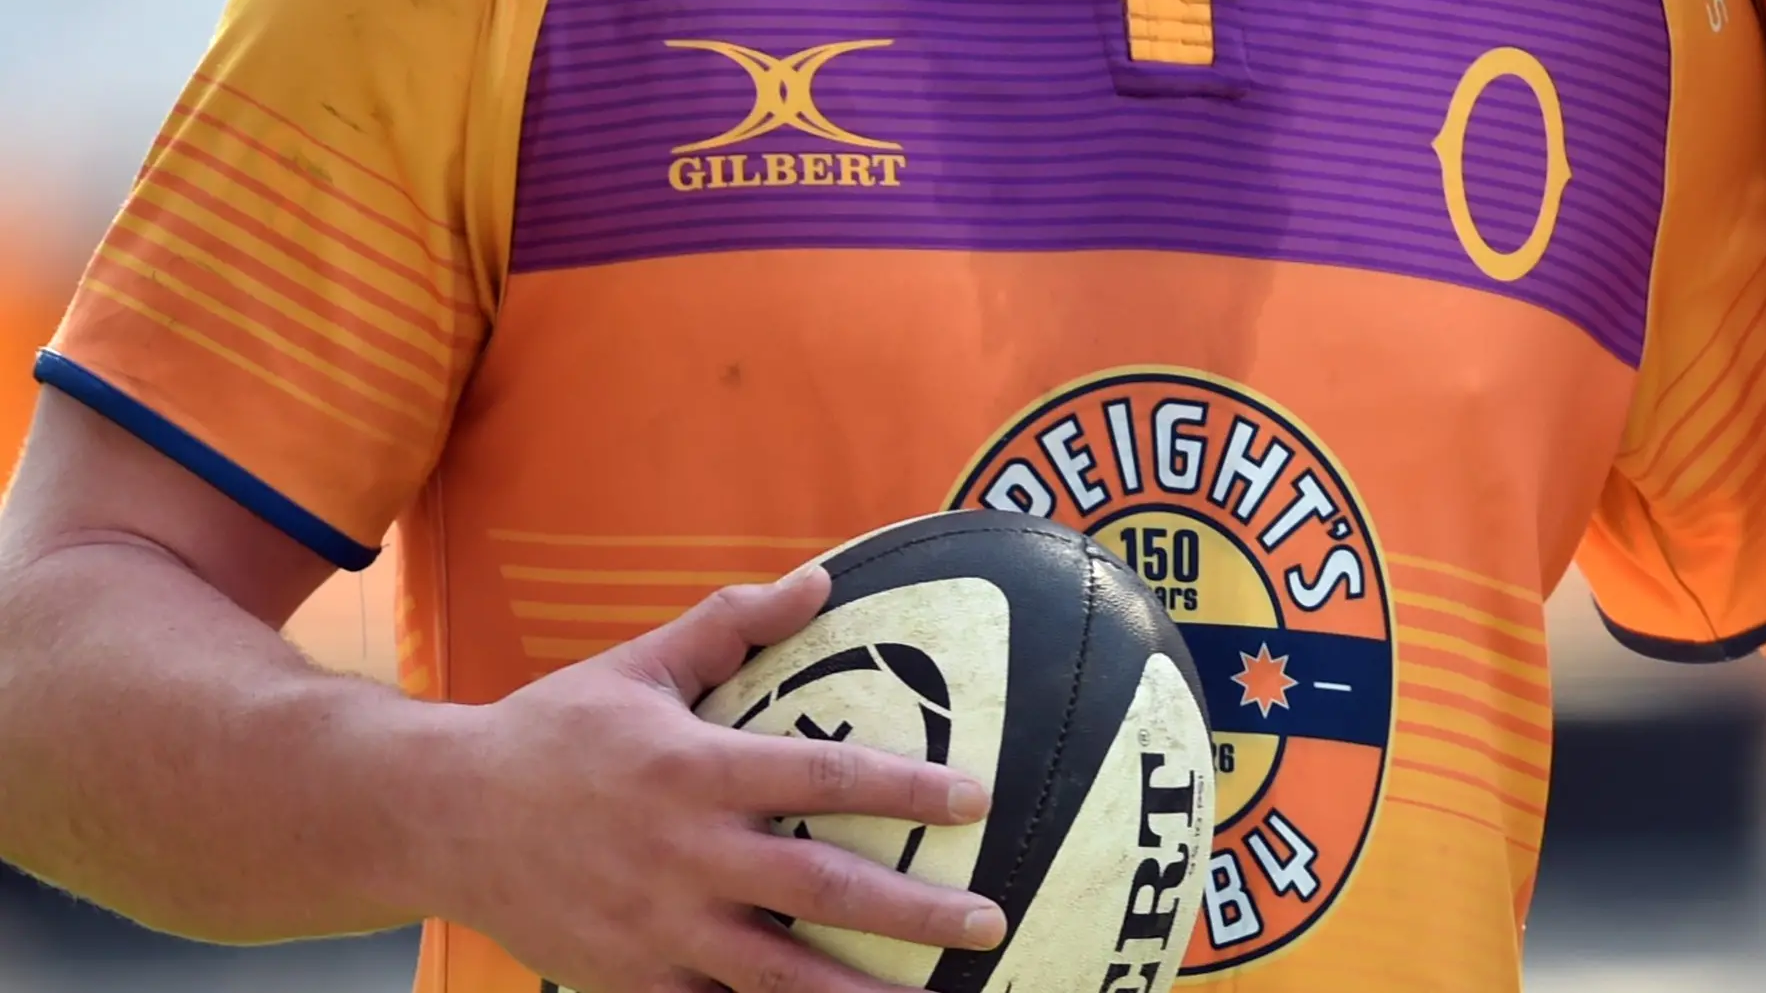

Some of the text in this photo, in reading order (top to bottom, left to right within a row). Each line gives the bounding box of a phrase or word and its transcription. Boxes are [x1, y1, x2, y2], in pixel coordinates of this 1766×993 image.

[667, 152, 907, 192] GILBERT
[978, 396, 1365, 613] PEIGHT'S
[1120, 526, 1200, 584] 150
